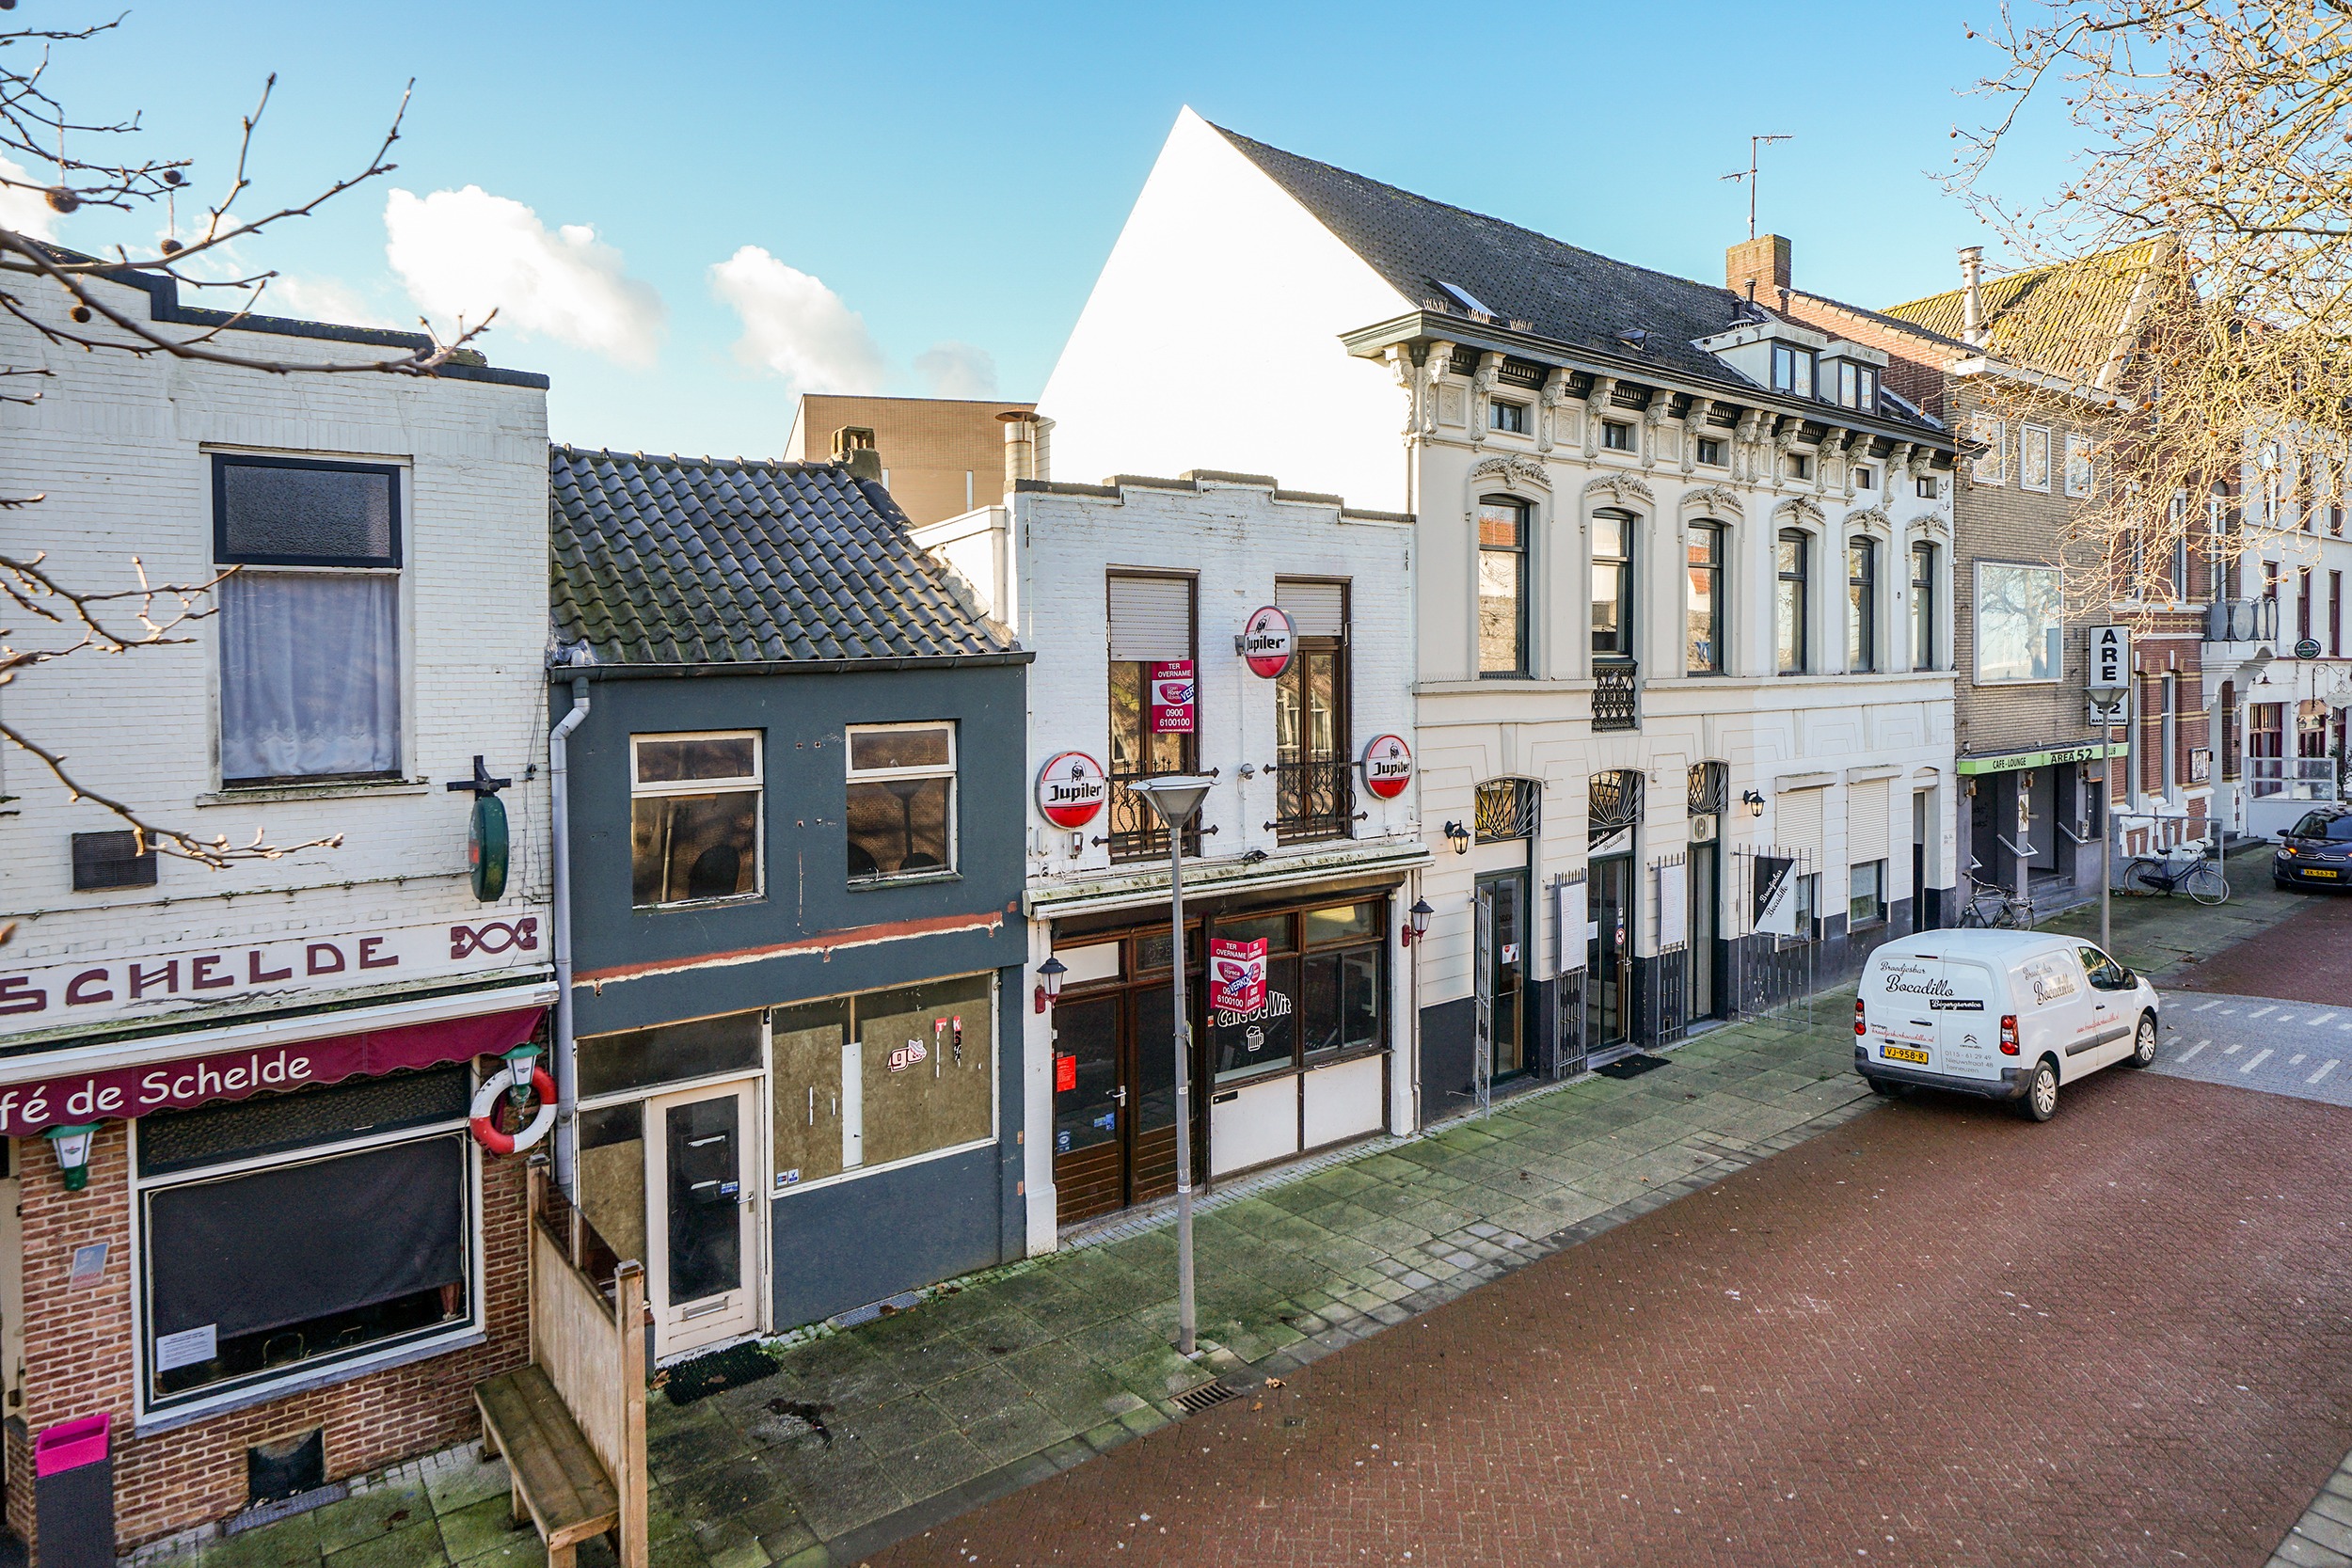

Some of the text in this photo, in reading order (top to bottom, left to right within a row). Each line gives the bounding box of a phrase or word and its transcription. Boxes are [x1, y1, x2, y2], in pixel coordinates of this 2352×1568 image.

[1247, 635, 1285, 653] Jupiler
[2101, 629, 2118, 681] ARE
[1158, 670, 1191, 678] OVERNAME
[1166, 708, 1184, 717] 0900
[1159, 718, 1190, 726] 6100100
[2052, 748, 2093, 764] AREA 52
[1373, 761, 1409, 777] Jupiler
[1048, 783, 1102, 802] Jupiler
[1766, 886, 1788, 918] Bocadillo
[1216, 948, 1248, 959] OVERNAME
[1880, 960, 1926, 975] Broodjesbar
[0, 937, 399, 1015] SCHELDE
[1223, 986, 1238, 997] 090
[1885, 974, 1954, 997] Bocadillo
[1217, 994, 1244, 1008] 6100100
[1268, 990, 1292, 1017] Wit
[1886, 1049, 1924, 1061] VJ-958-R
[1946, 1057, 1984, 1068] Nieuwstraat
[1947, 1064, 1979, 1073] Terneuzen
[0, 1050, 312, 1130] fé de Schelde
